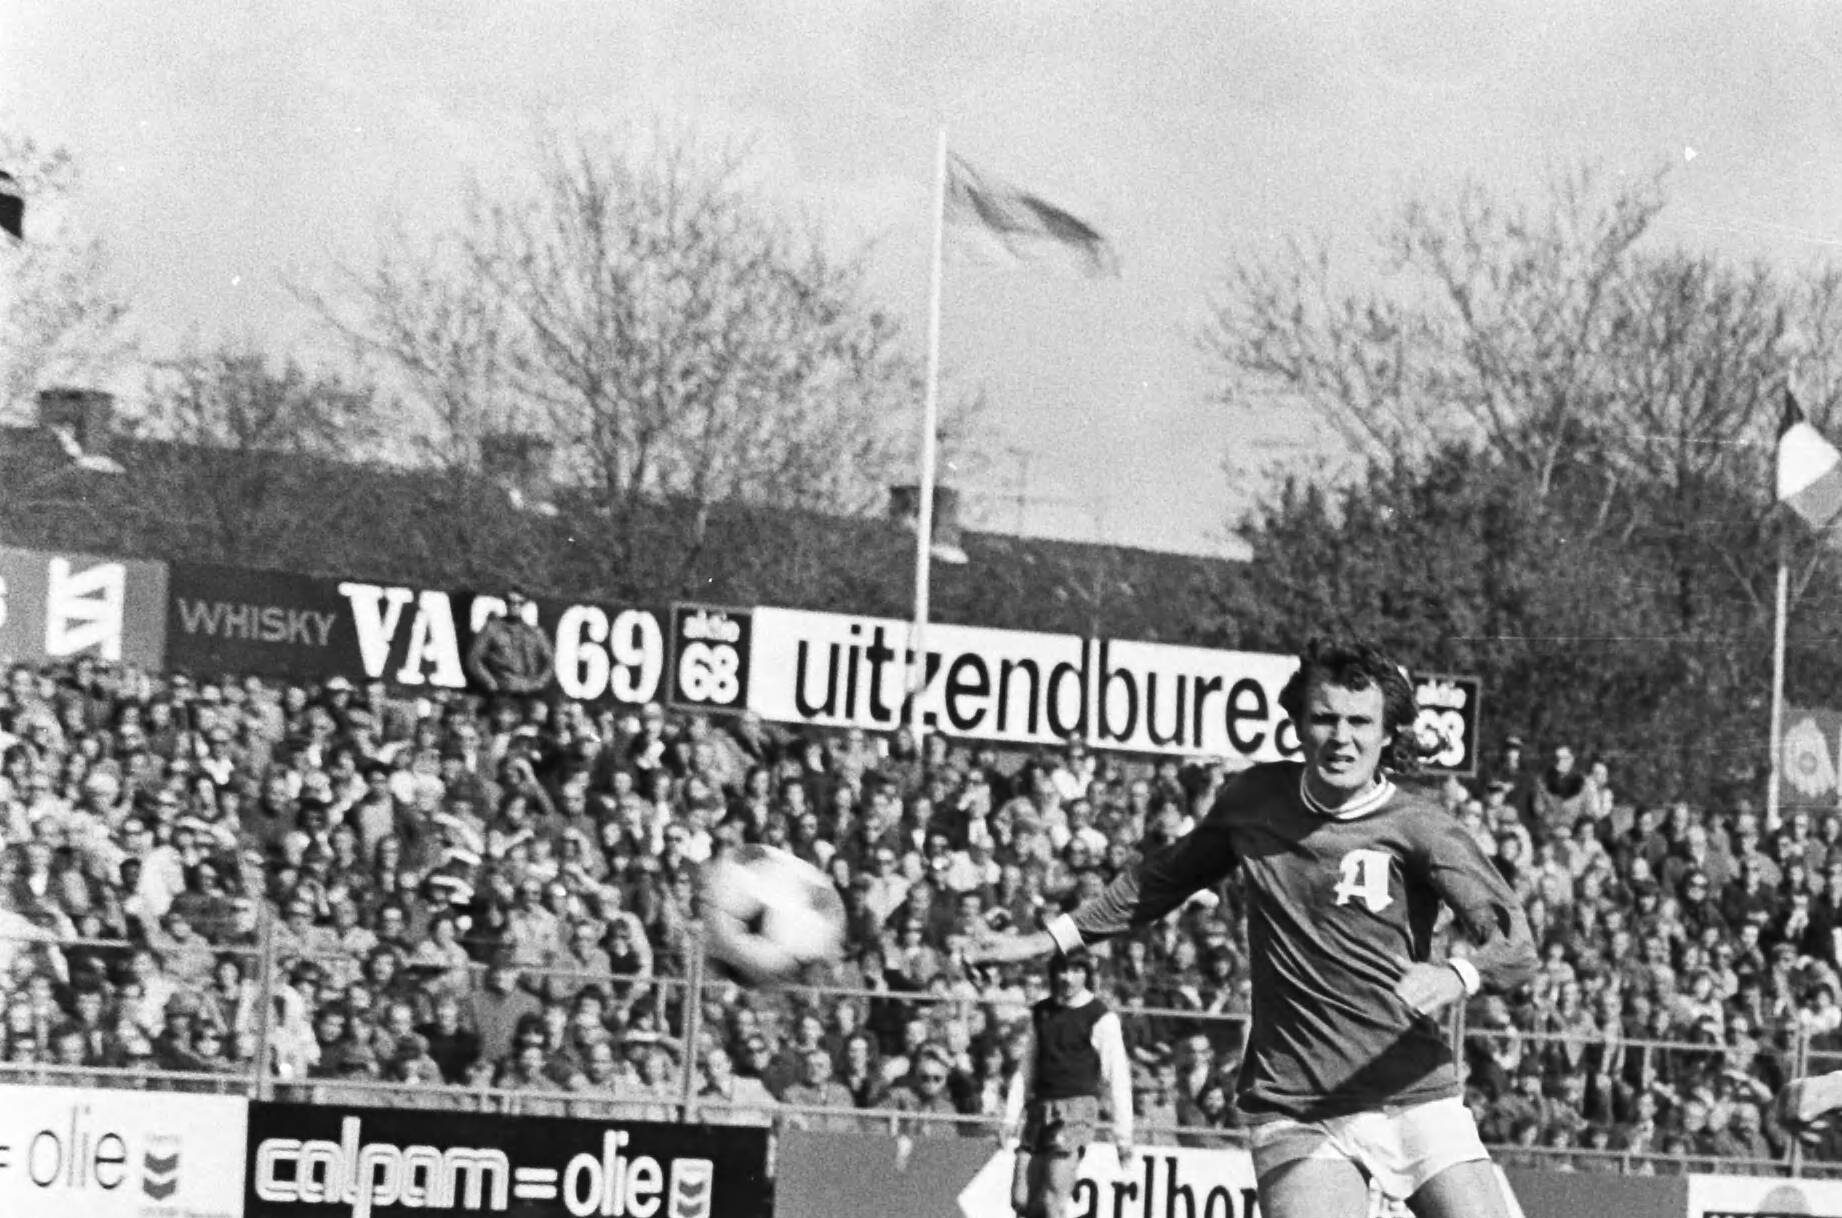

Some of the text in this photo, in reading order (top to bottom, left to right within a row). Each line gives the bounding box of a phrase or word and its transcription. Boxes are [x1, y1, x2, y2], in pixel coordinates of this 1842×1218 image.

[178, 598, 336, 646] WHISKY
[555, 604, 664, 703] 69
[679, 641, 740, 703] 68
[795, 623, 1301, 757] uitzendbure
[29, 1105, 127, 1190] olie
